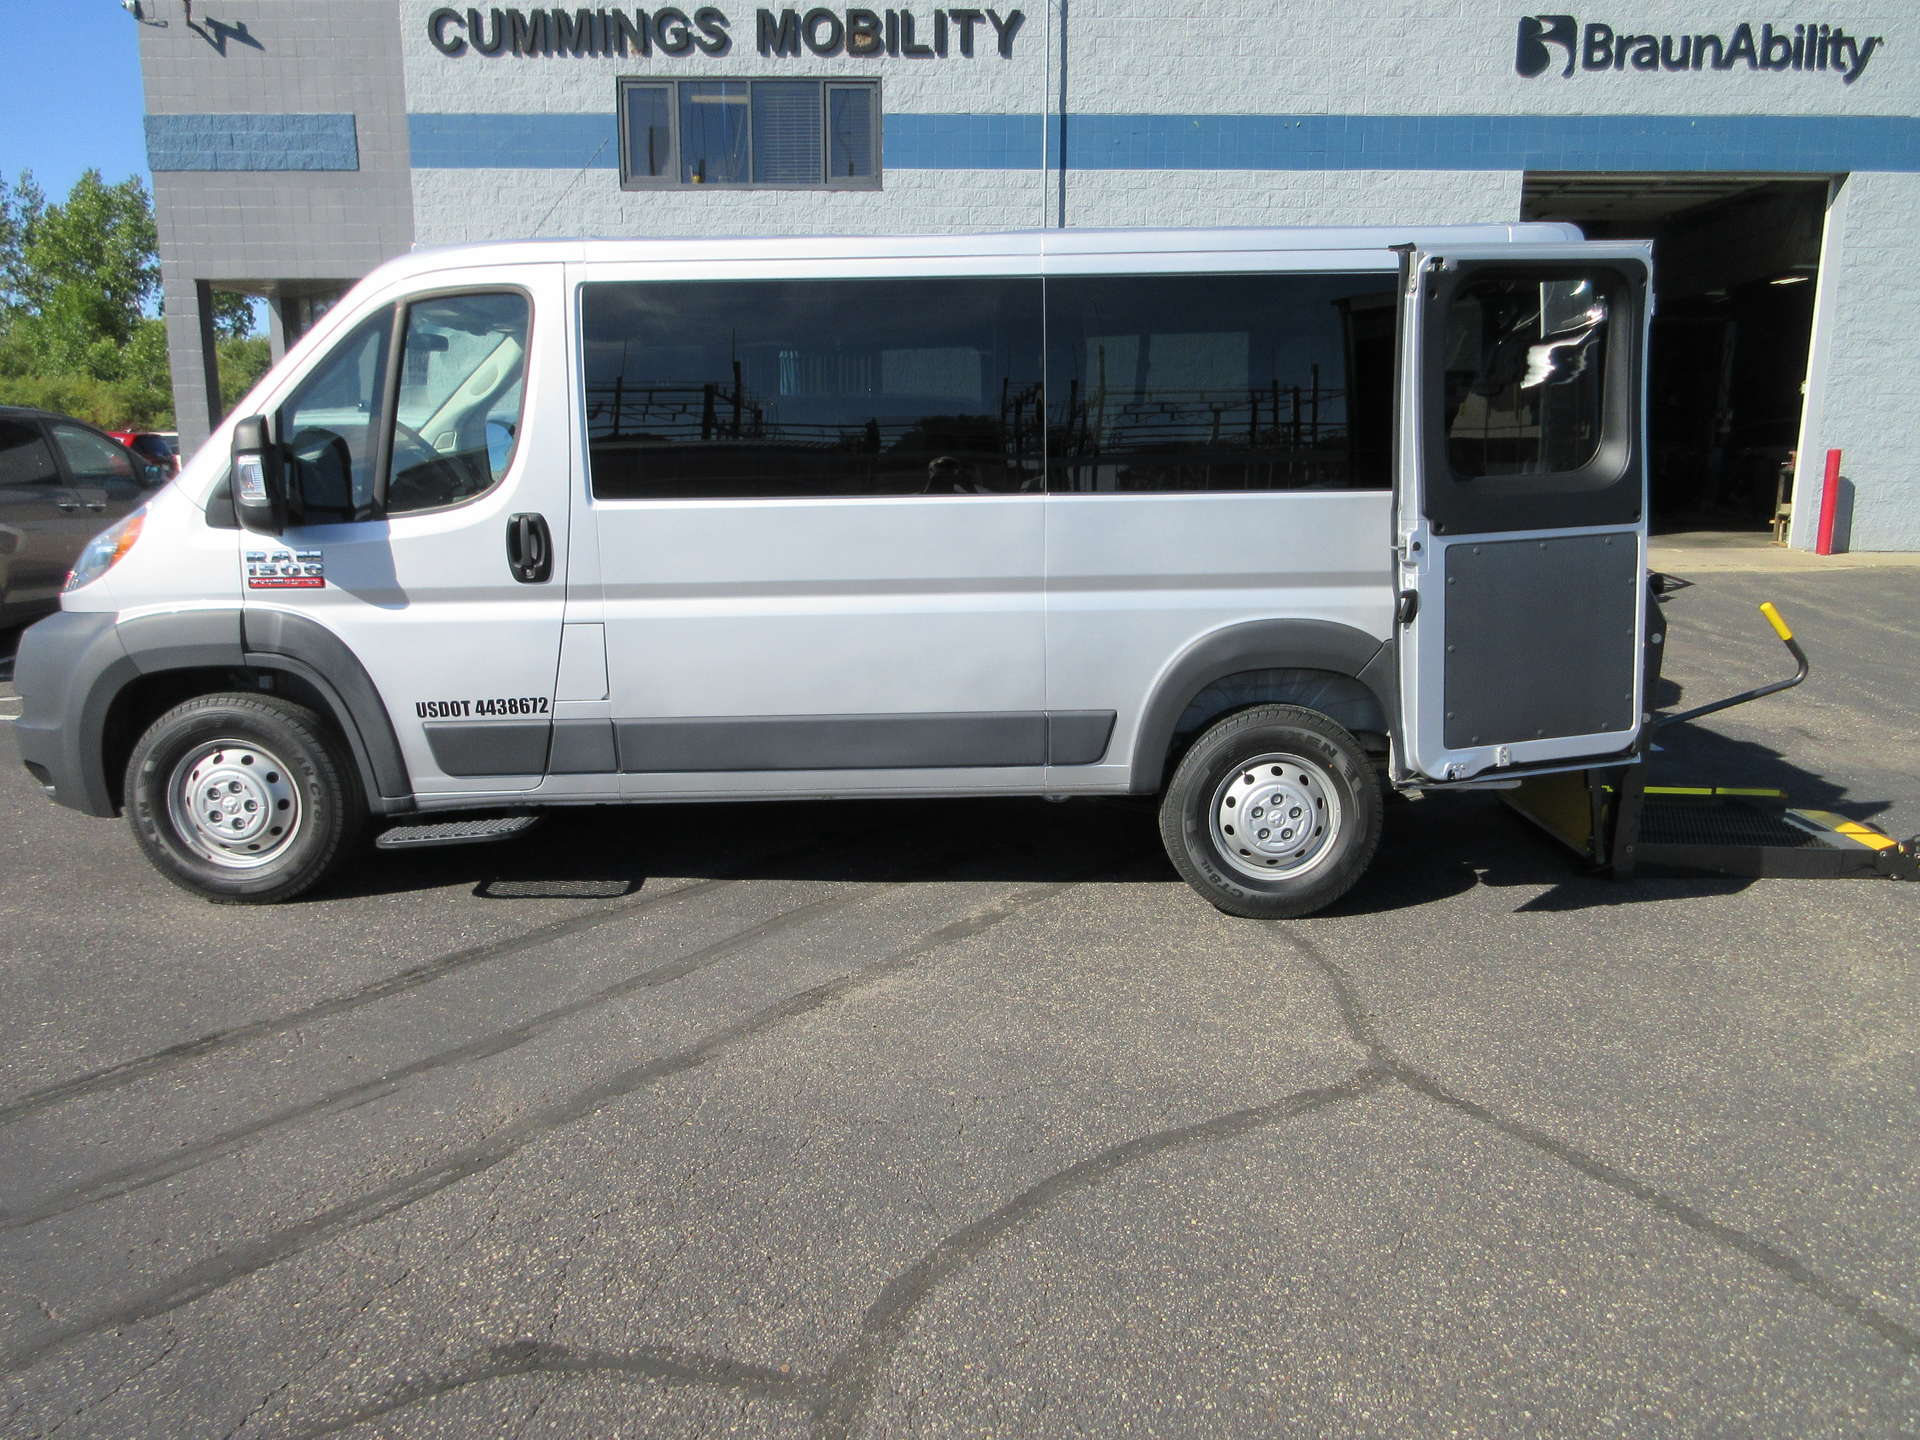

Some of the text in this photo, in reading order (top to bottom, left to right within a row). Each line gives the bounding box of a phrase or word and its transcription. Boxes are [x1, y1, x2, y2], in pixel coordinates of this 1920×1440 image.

[427, 7, 1027, 58] CUMMINGS MOBILITY
[1582, 22, 1883, 85] BraunAbility
[246, 550, 323, 562] RAM
[415, 697, 549, 718] USDOT 4438672
